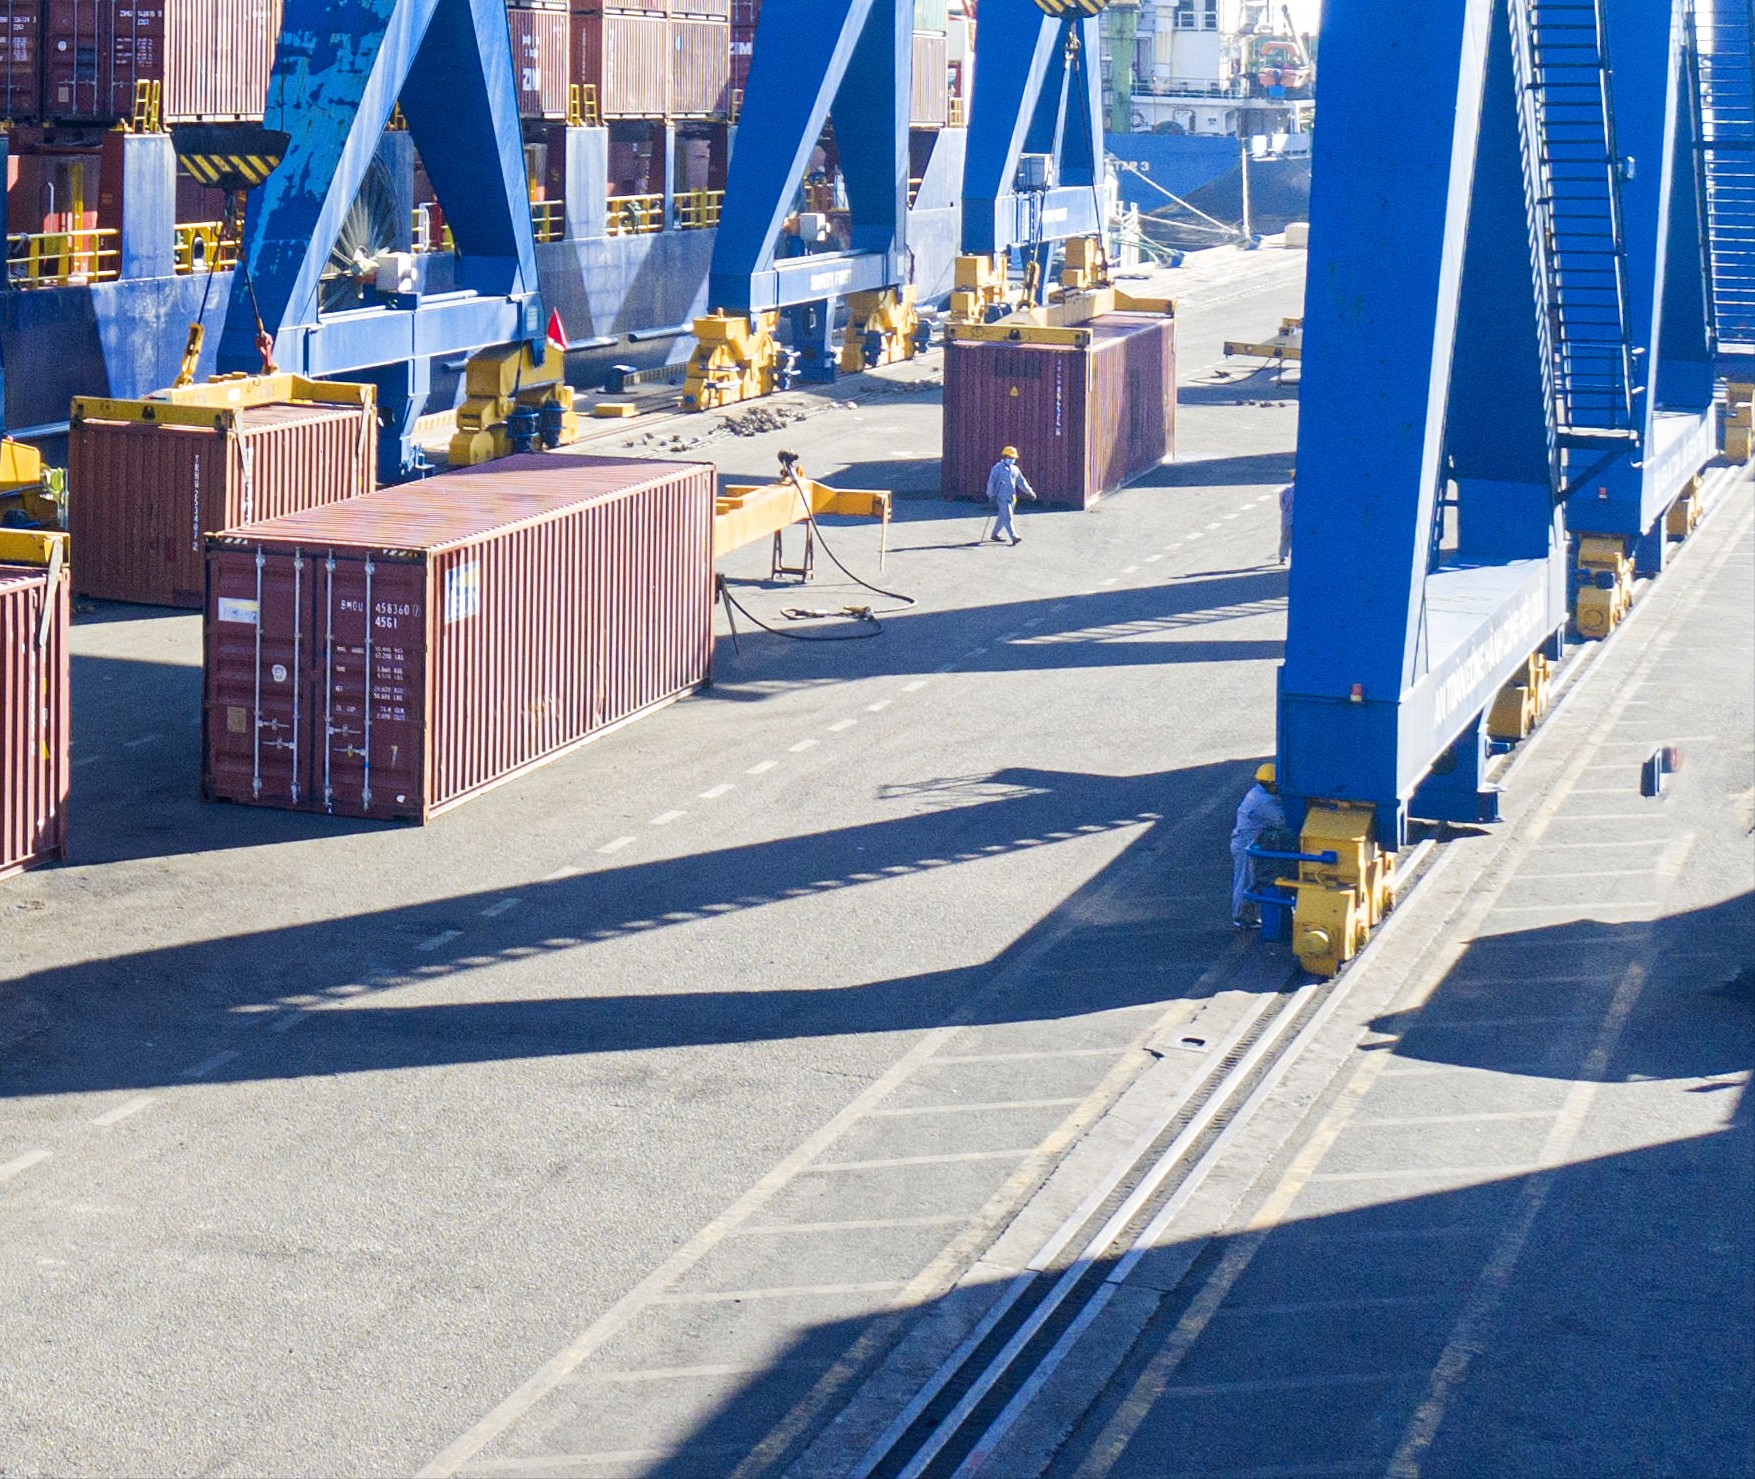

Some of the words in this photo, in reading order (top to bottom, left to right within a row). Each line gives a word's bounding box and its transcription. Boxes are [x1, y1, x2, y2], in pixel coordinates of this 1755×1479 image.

[730, 41, 753, 55] ZIM
[1112, 160, 1138, 172] TAR
[1140, 160, 1150, 172] 3
[341, 599, 364, 612] BMOU
[375, 601, 410, 616] 458360
